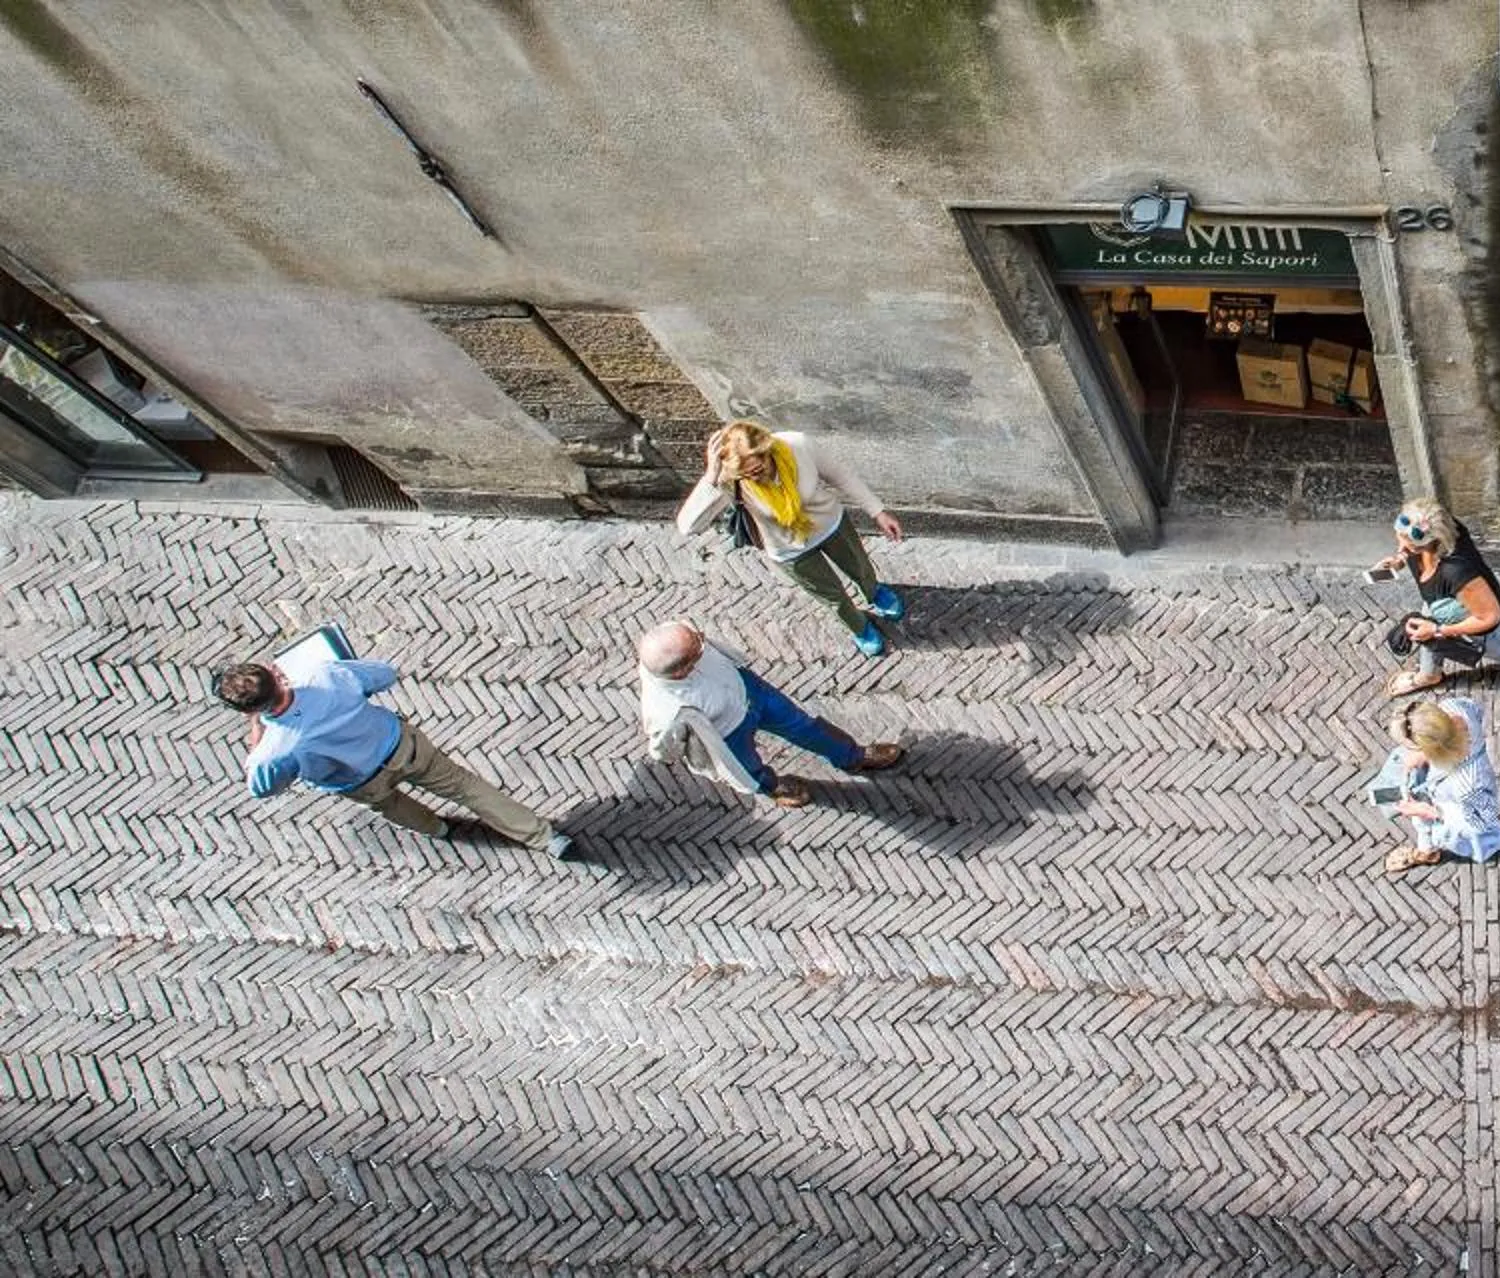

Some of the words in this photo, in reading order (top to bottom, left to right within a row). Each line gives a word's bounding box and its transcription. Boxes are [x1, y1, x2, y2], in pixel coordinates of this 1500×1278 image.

[1398, 205, 1454, 233] 26
[1097, 249, 1126, 264] La
[1133, 250, 1192, 265] Casa
[1199, 250, 1233, 265] dei
[1241, 250, 1319, 268] Sapori
